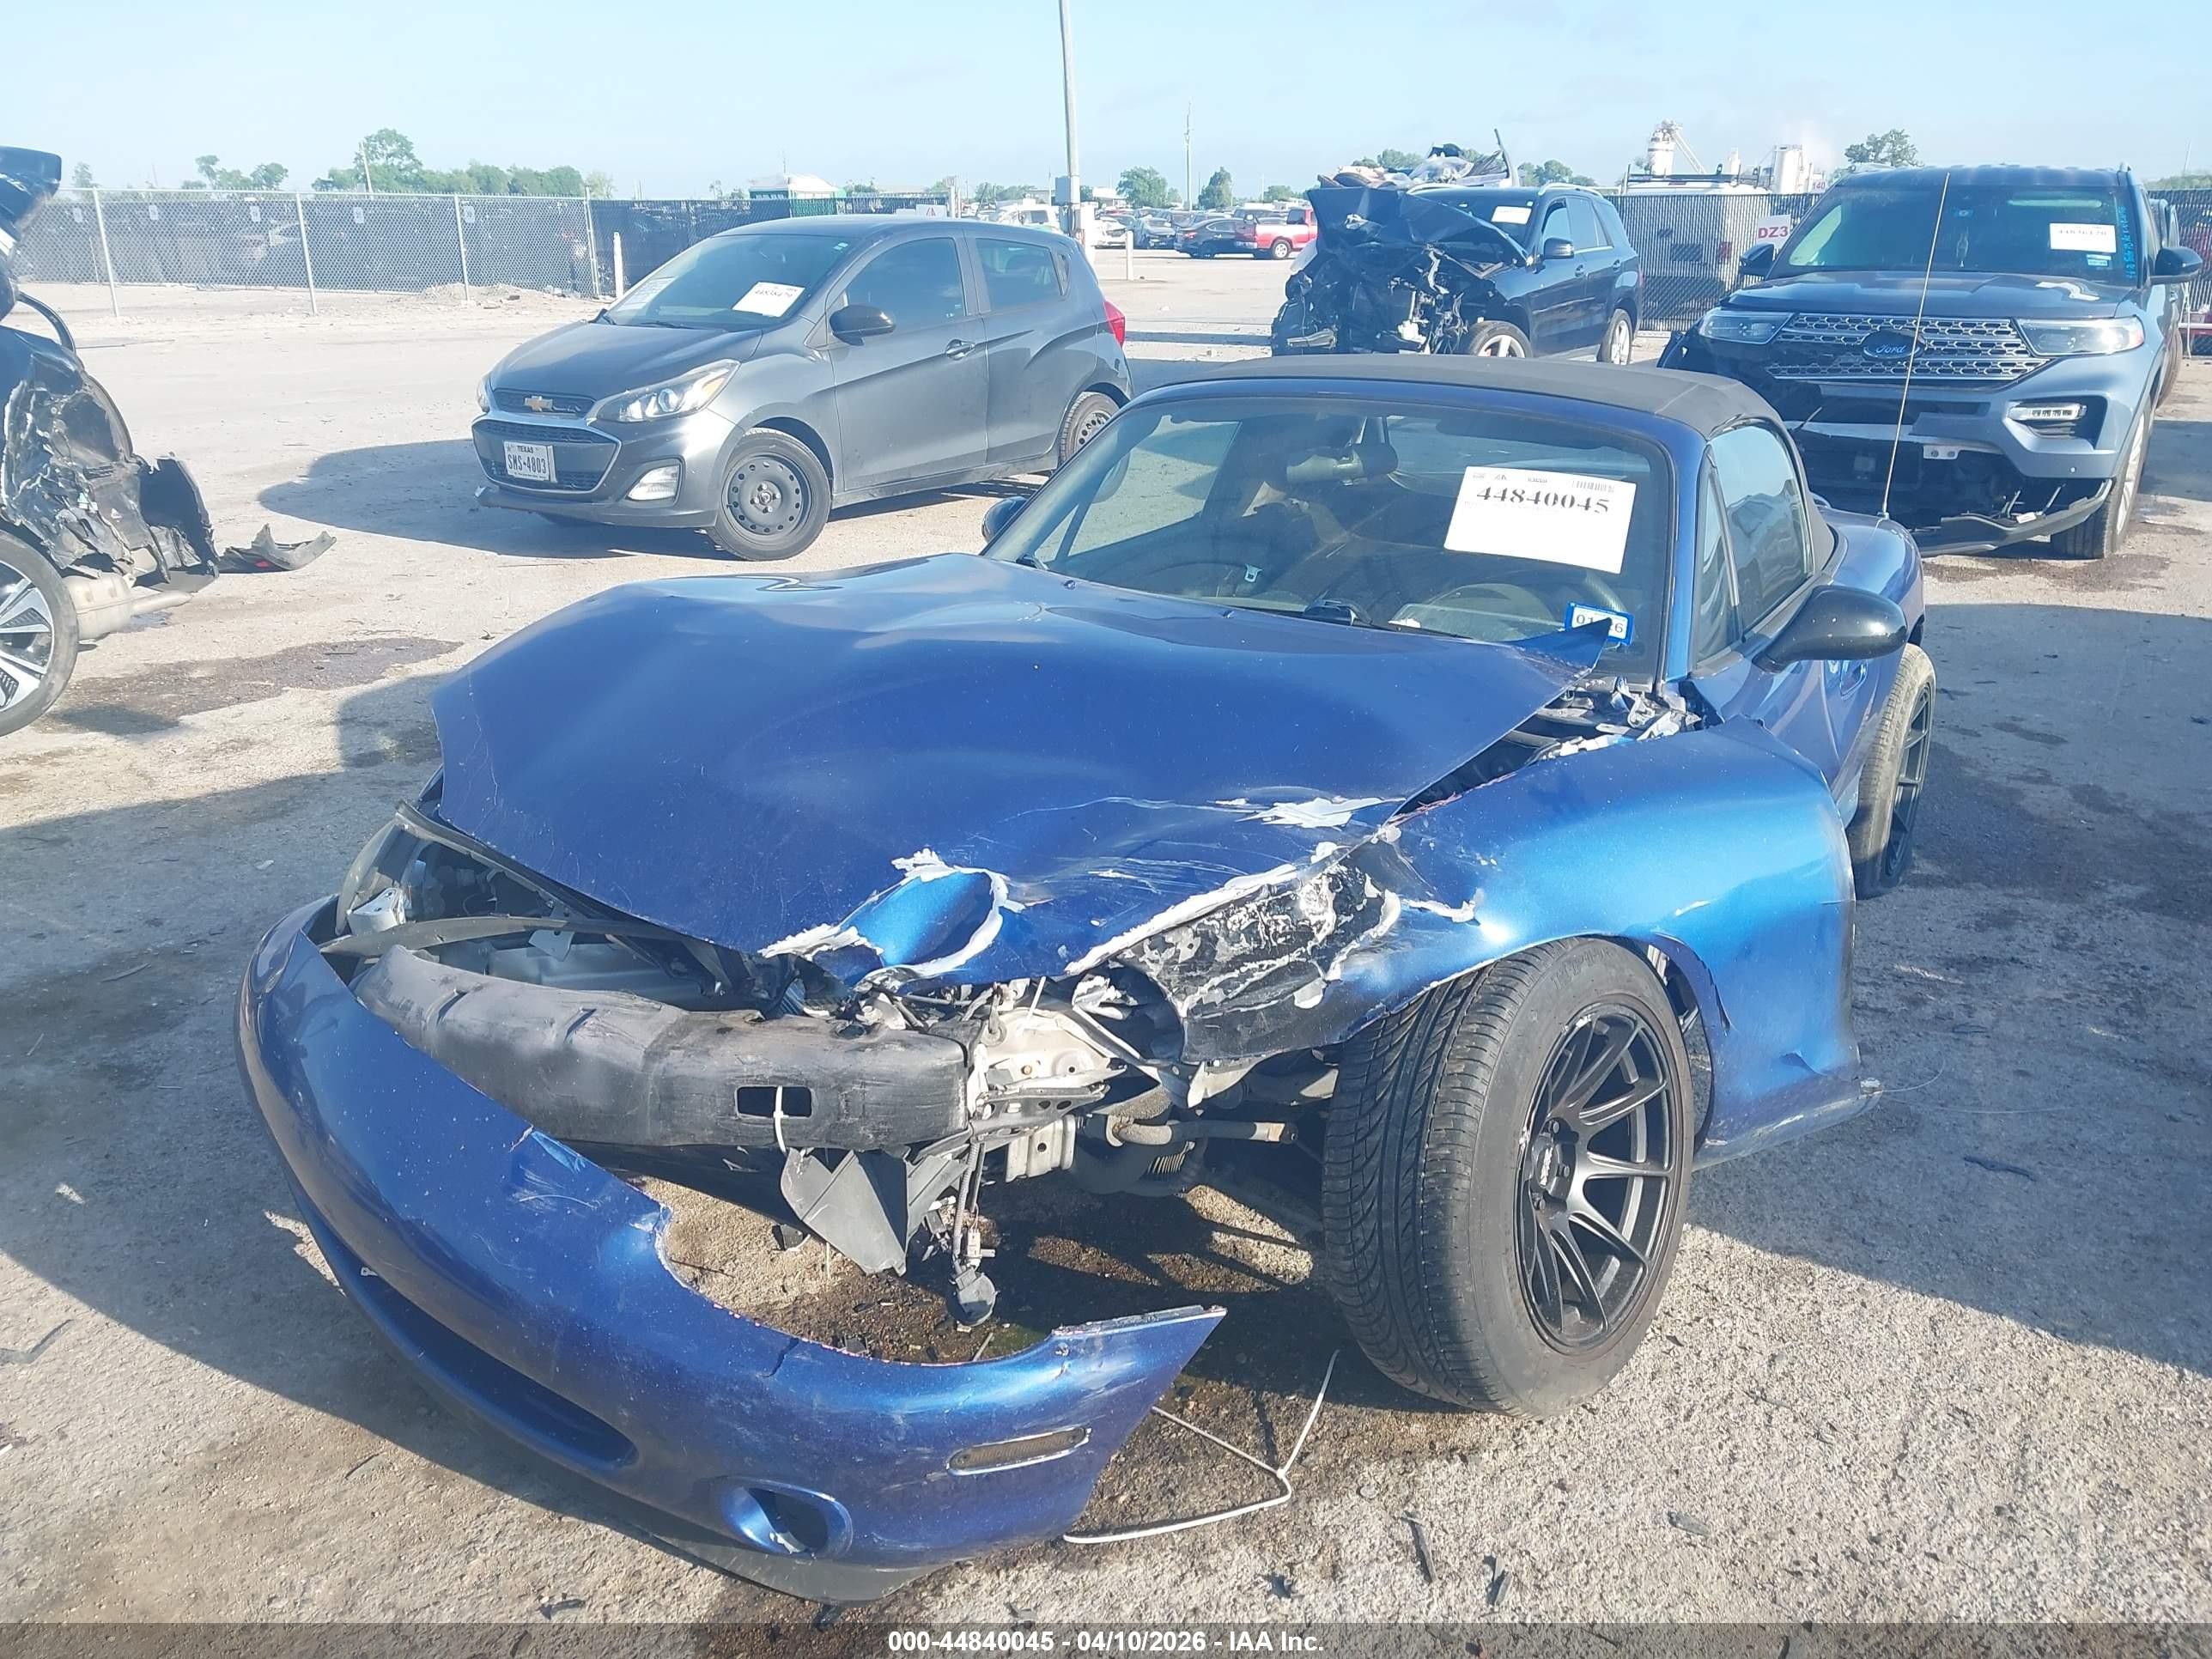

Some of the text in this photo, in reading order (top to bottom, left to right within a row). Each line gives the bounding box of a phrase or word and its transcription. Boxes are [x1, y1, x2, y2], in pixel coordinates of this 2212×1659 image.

[1758, 226, 1789, 239] DZ3
[1875, 344, 1907, 354] Ford
[517, 445, 534, 453] TEXAS
[1476, 486, 1610, 514] 44840045
